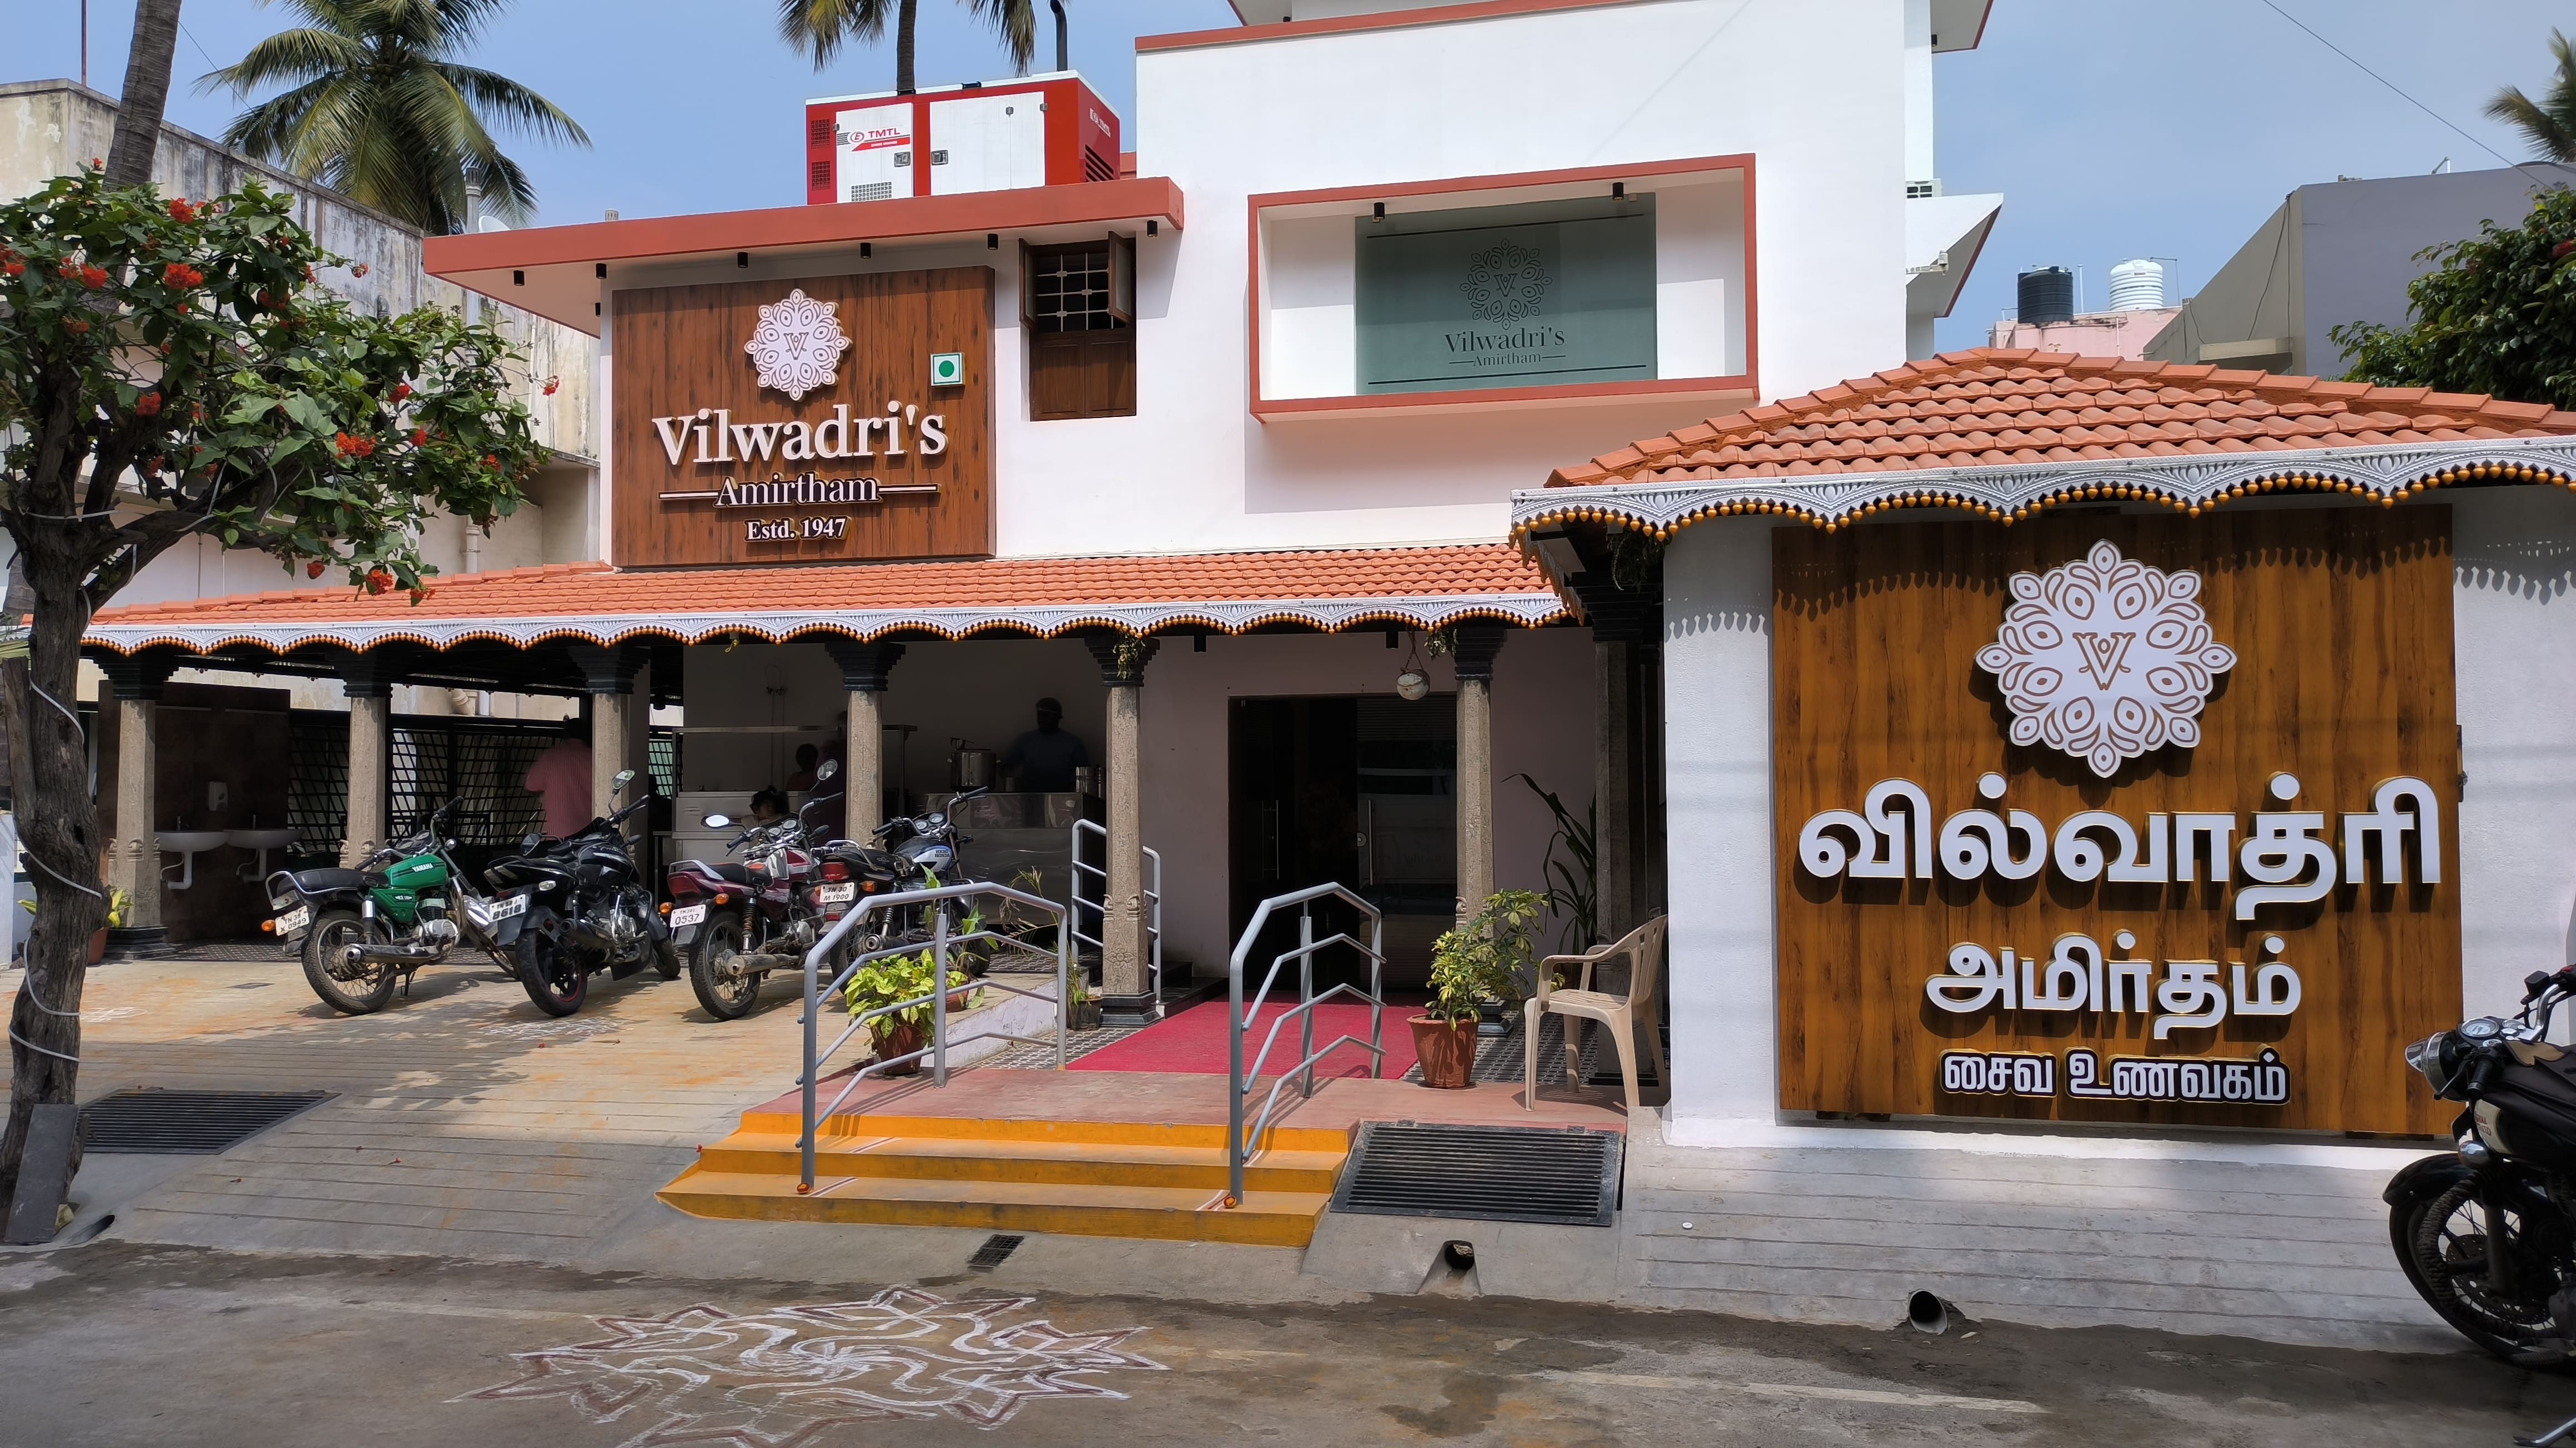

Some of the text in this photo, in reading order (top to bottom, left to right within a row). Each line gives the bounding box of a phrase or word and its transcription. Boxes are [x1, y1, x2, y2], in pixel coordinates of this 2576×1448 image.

[868, 128, 900, 138] TMTL
[1445, 326, 1565, 353] Vilwadri's
[1473, 352, 1541, 366] Amirtham
[652, 400, 949, 465] Vilwadri's
[716, 473, 878, 506] Amirtham
[746, 518, 846, 540] Estd. 1947
[1799, 772, 2441, 921] வில்வாத்ரி
[412, 863, 434, 872] YAMAHA
[288, 917, 306, 929] 0949
[492, 904, 522, 920] 8618
[675, 913, 700, 925] 0537
[1926, 931, 2301, 1040] அமிர்தம்
[1944, 1053, 2286, 1100] சைவ உணவகம்
